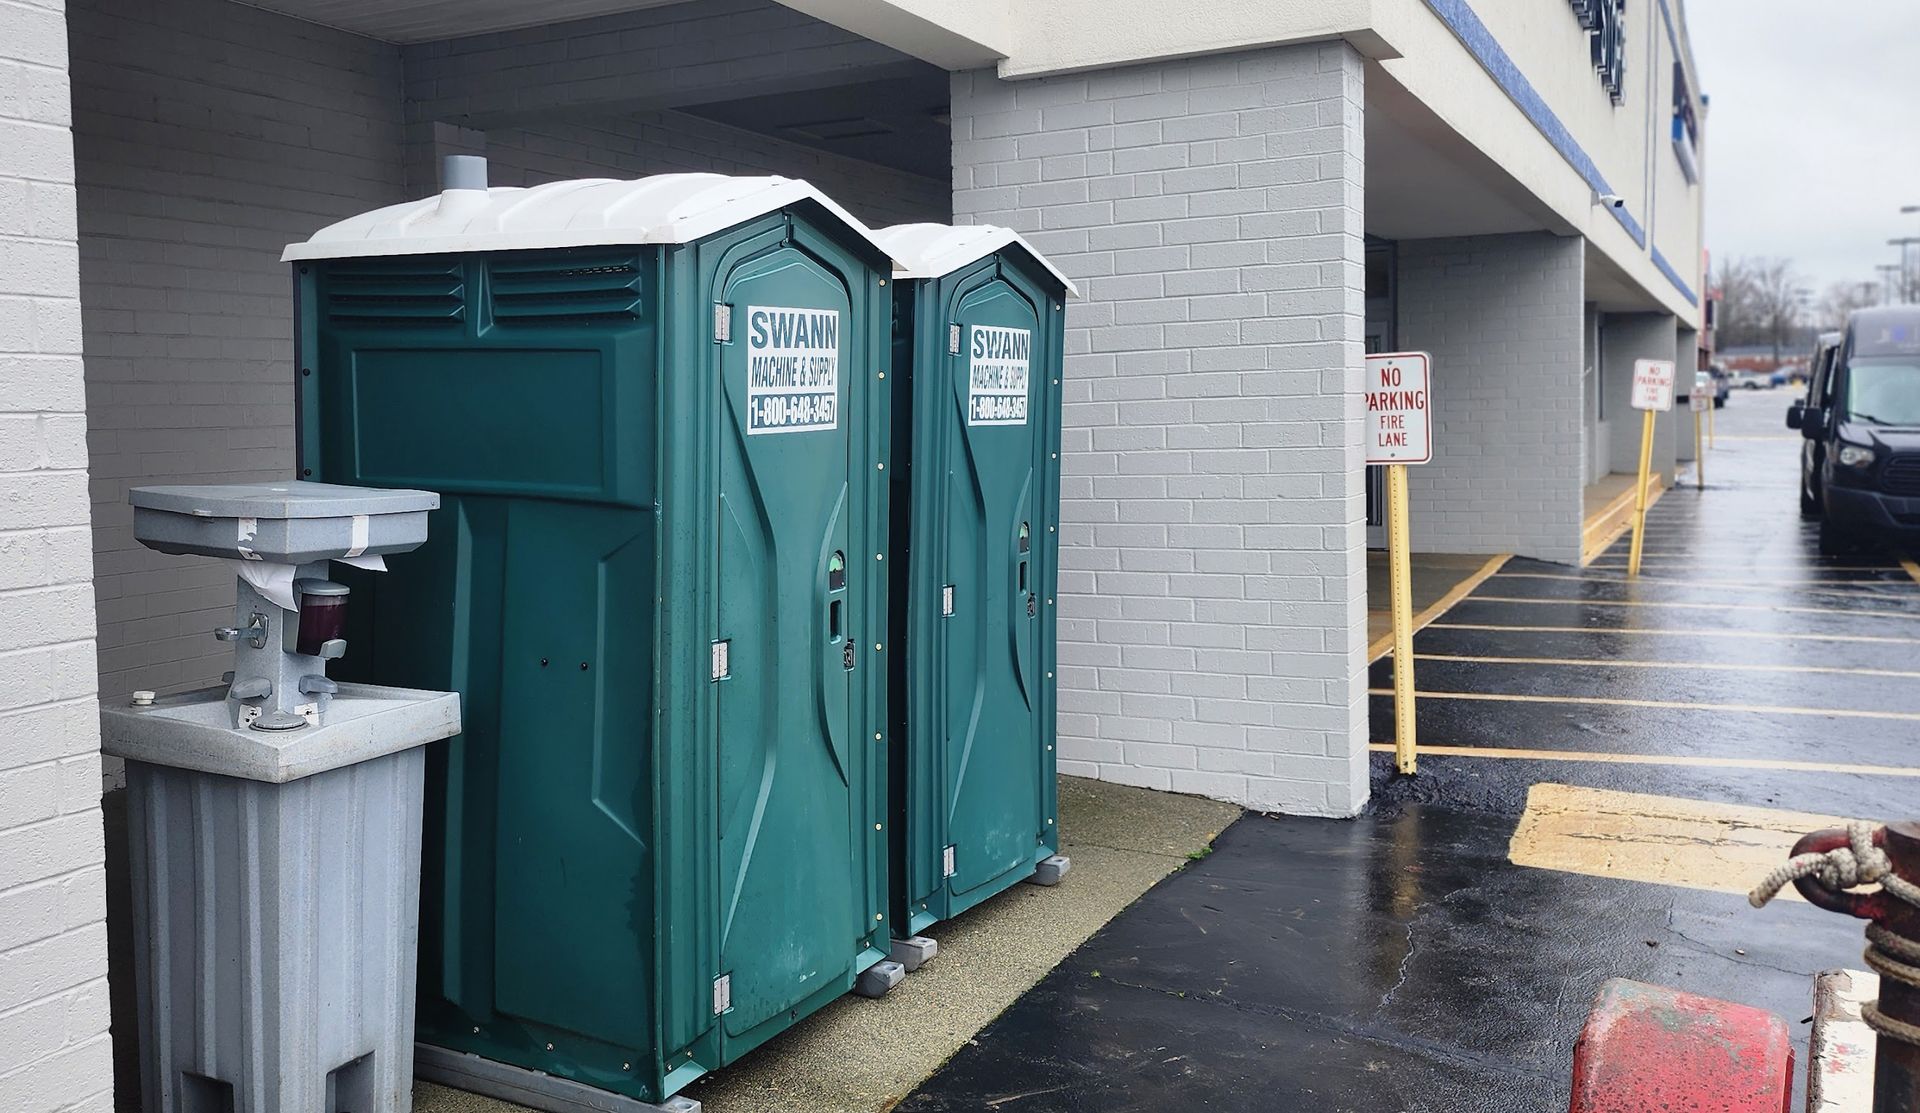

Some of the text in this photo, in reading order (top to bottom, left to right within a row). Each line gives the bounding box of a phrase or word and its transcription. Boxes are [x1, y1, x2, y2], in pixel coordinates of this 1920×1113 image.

[751, 311, 836, 349] SWANN
[973, 329, 1029, 360] SWANN
[751, 356, 836, 388] MACHINE & SUPPLY
[972, 365, 1003, 389] MACHINE
[1381, 368, 1400, 387] NO
[751, 396, 835, 426] 1-800-648-3457
[1380, 415, 1405, 429] FIRE
[1378, 432, 1408, 447] LANE
